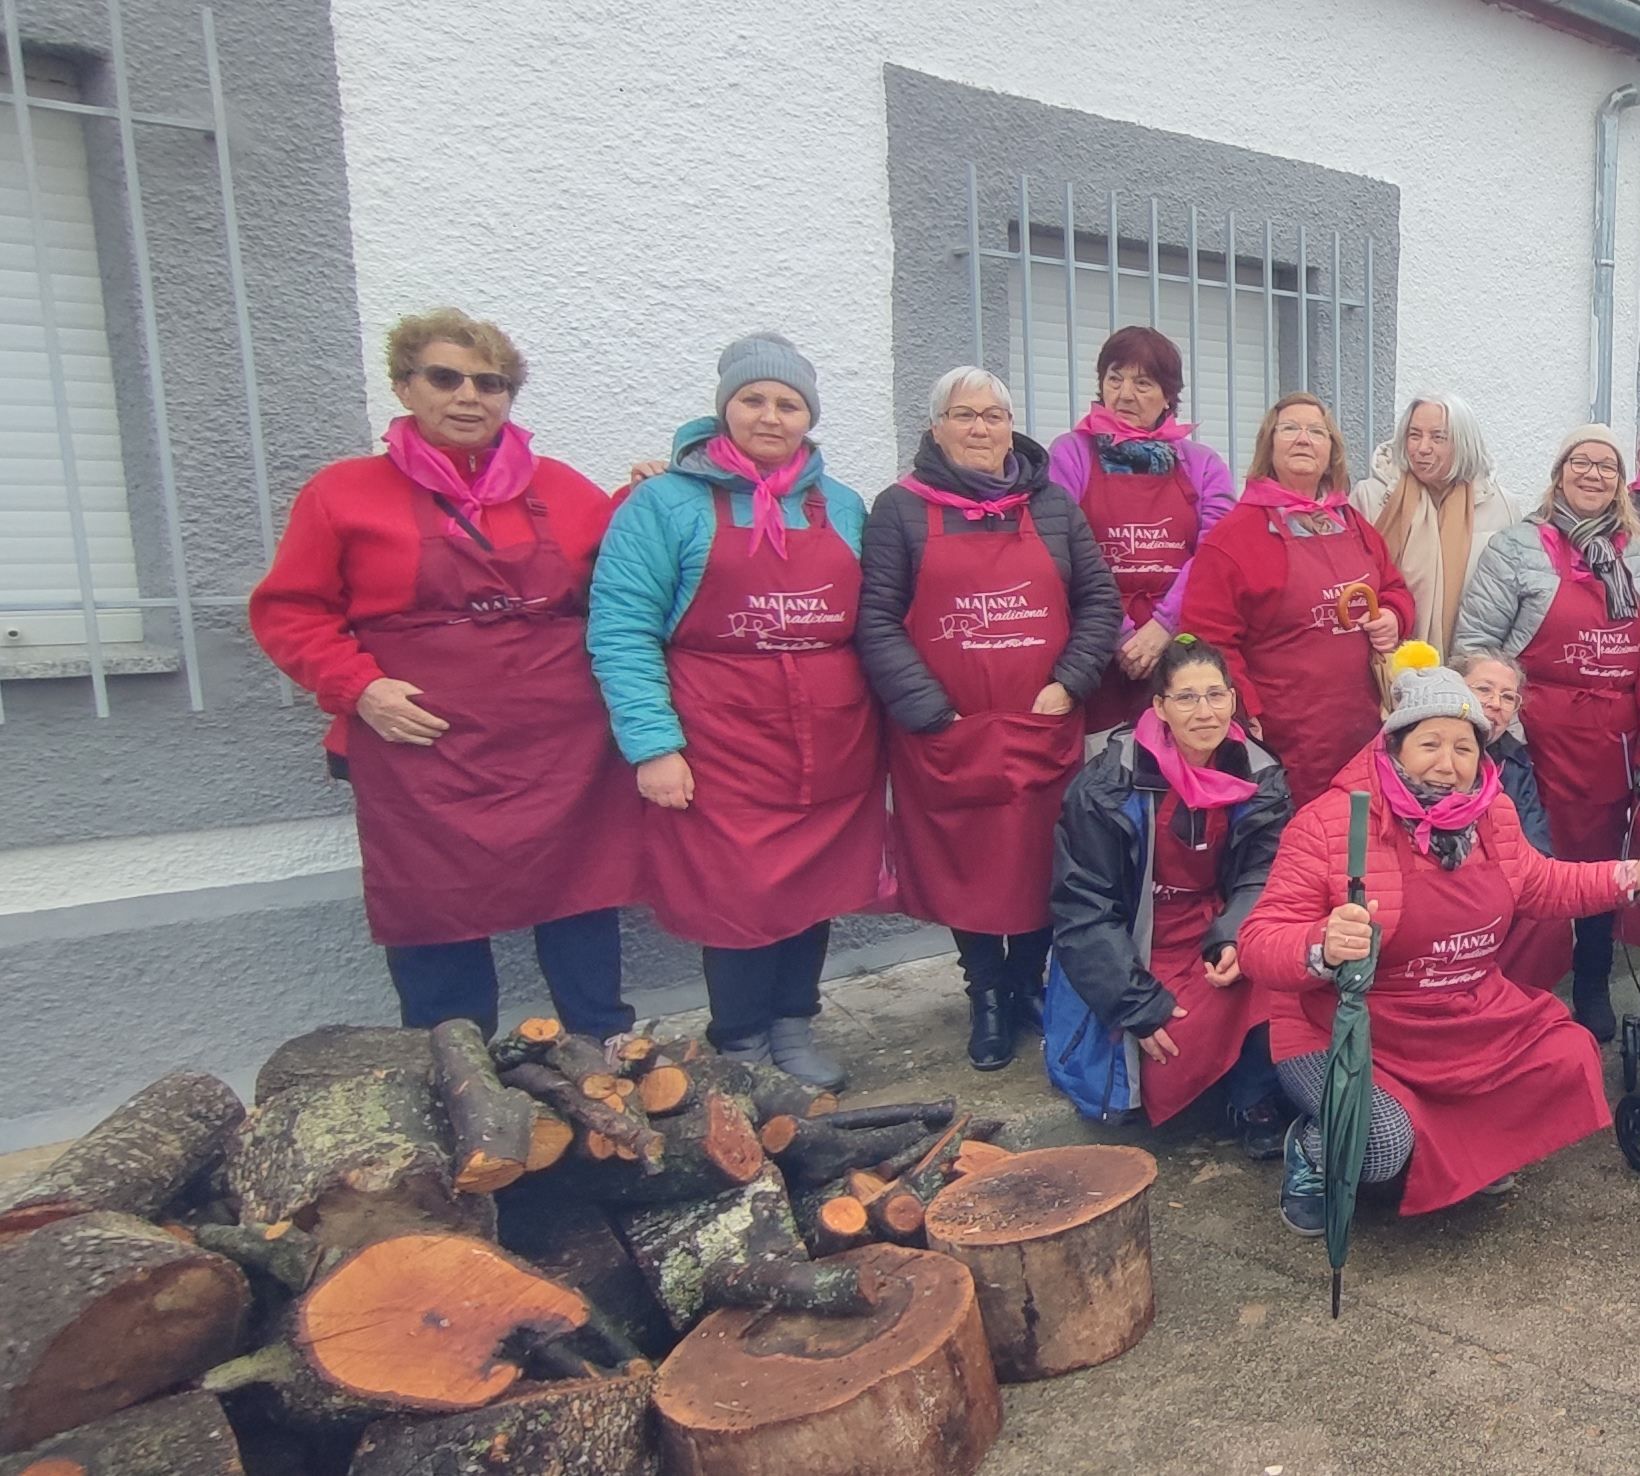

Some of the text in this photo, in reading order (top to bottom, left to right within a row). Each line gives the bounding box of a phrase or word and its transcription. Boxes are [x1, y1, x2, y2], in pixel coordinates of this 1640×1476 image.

[1108, 517, 1173, 543] MATANZA
[747, 584, 833, 616] MATANZA
[954, 581, 1031, 614] MATANZA
[1578, 622, 1633, 648] MATANZA
[1431, 915, 1502, 957] MATANZA
